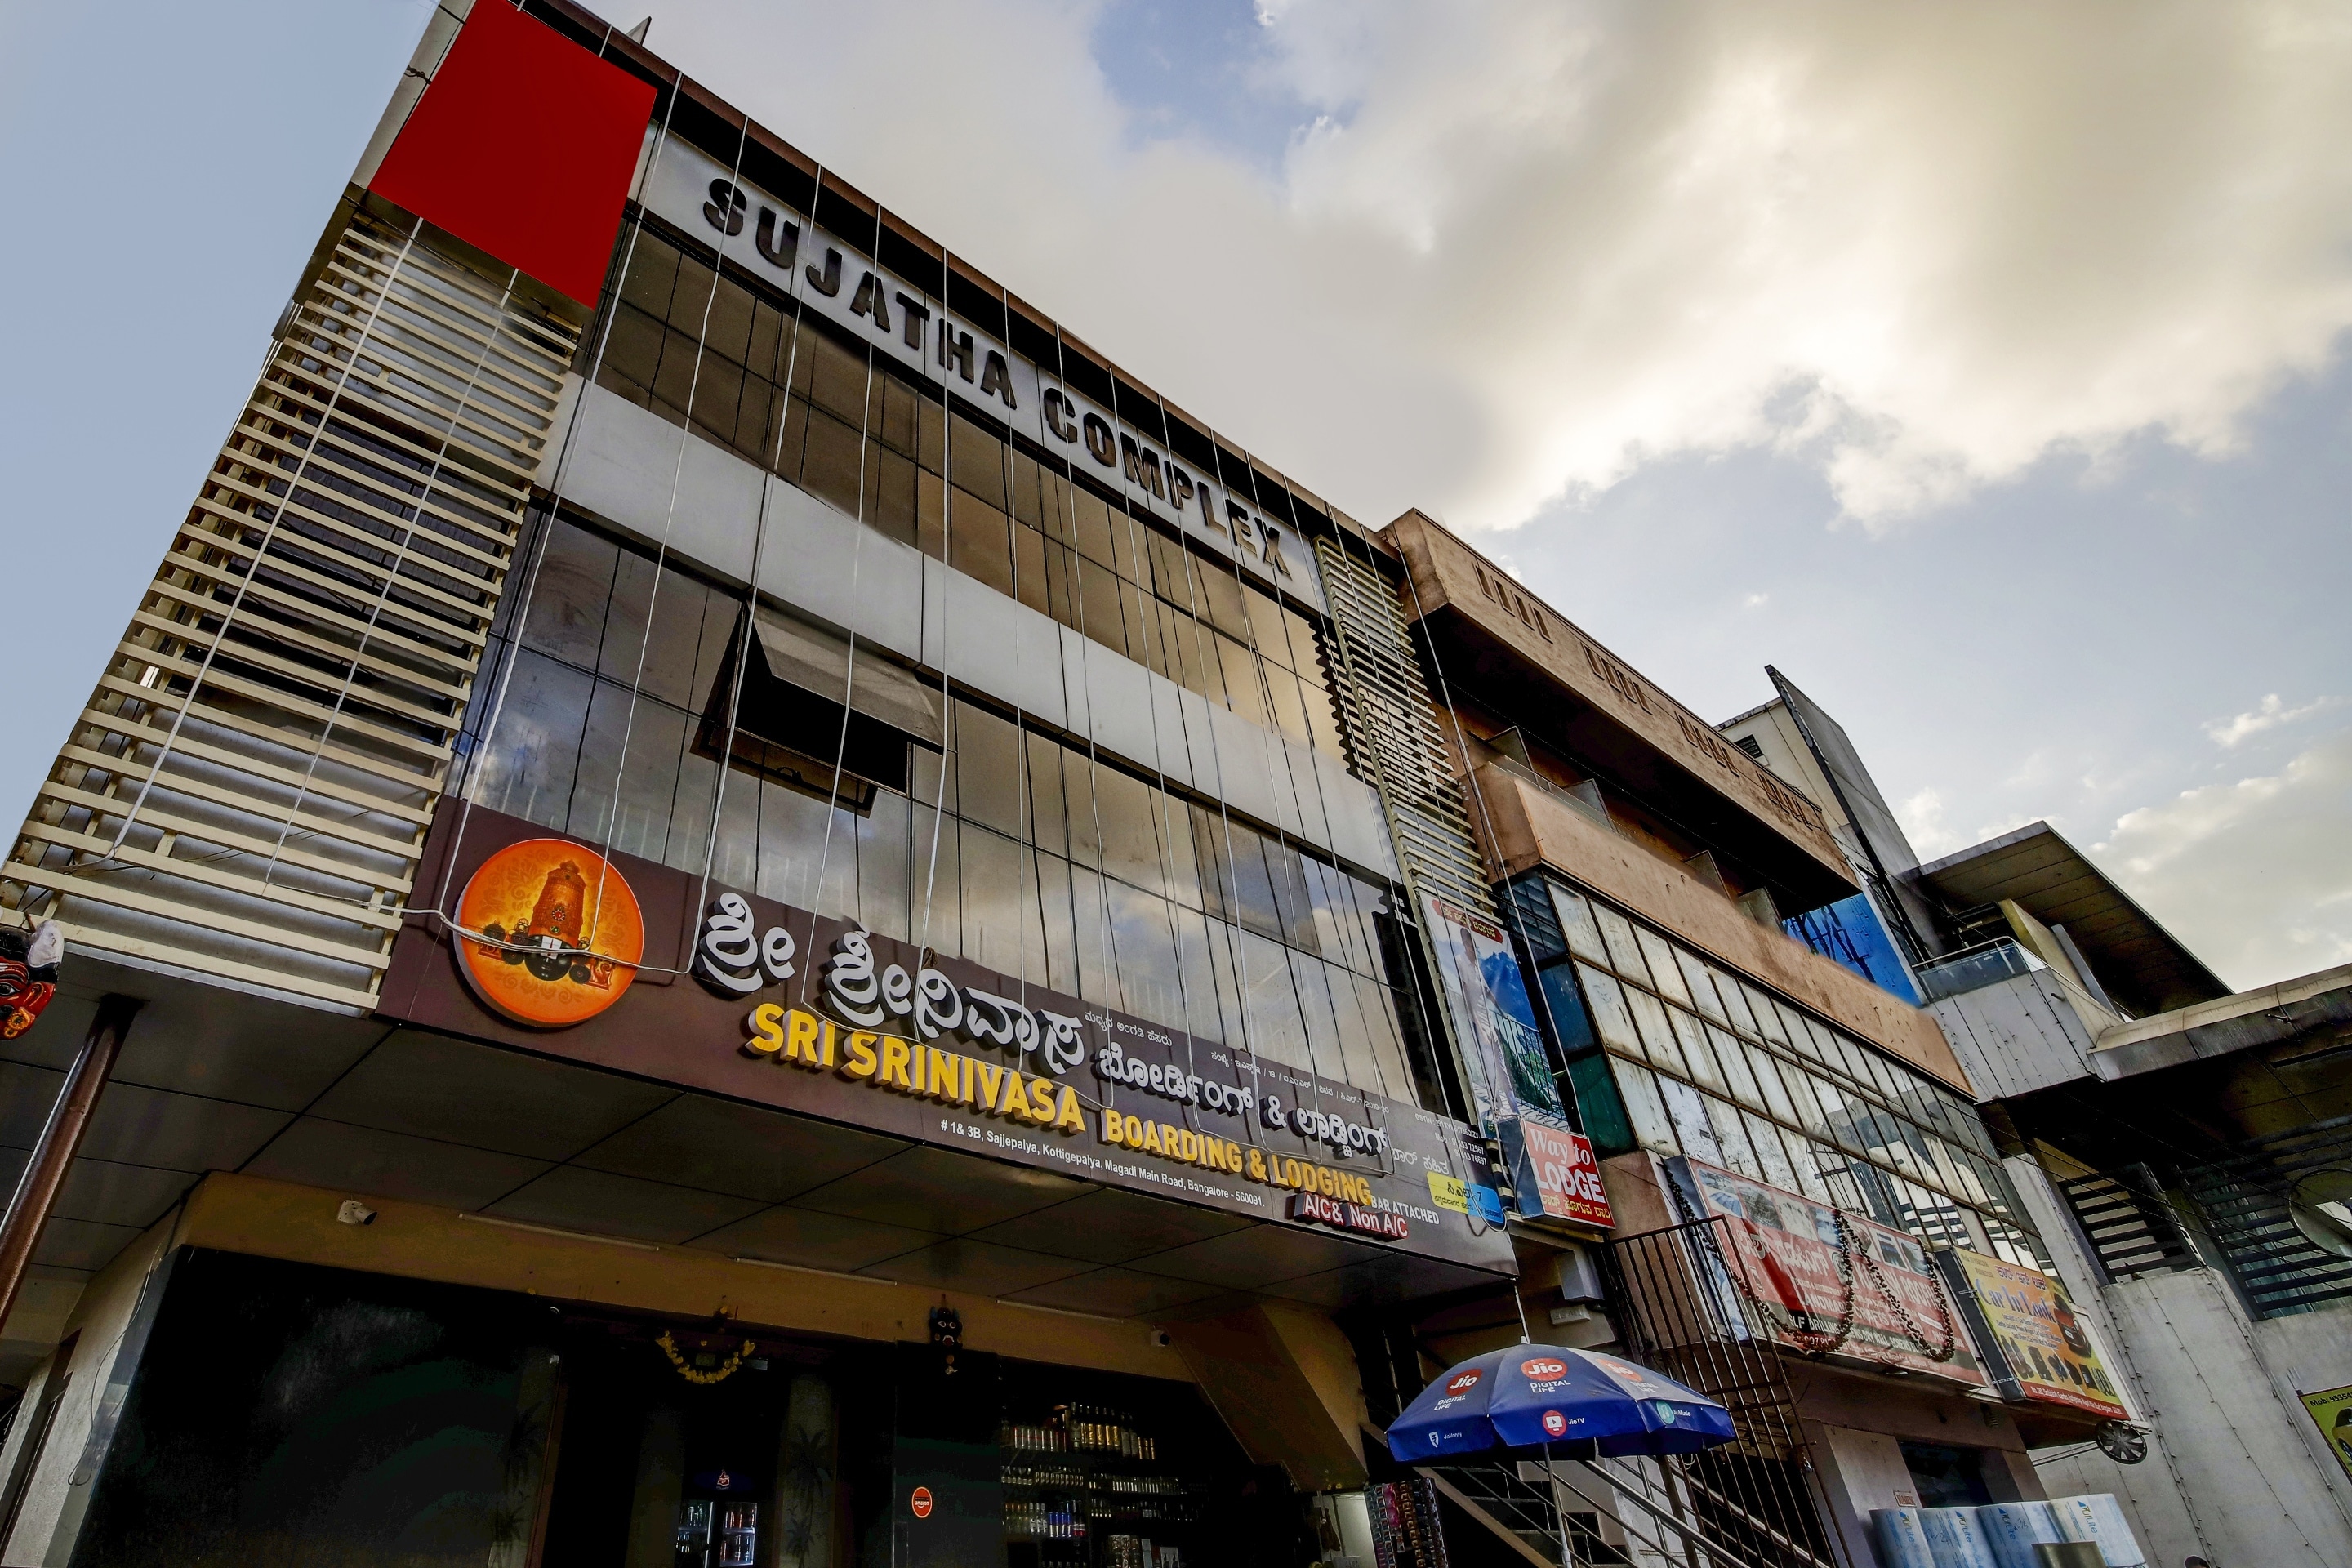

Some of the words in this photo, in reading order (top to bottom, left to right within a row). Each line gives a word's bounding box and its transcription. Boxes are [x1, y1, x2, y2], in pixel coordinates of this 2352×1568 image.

[703, 177, 1018, 410] SUJATHA
[1044, 386, 1292, 579] COMPLEX
[694, 892, 795, 993] ಶ್ರೀ
[826, 930, 1086, 1076] ಶ್ರೀನಿವಾಸ
[746, 1003, 836, 1067] SRI
[842, 1030, 1086, 1134] SRINIVASA
[1267, 1095, 1287, 1128] &
[1103, 1109, 1243, 1174] BOARDING
[1247, 1149, 1267, 1183] &
[1271, 1155, 1372, 1205] LODGING
[1529, 1128, 1568, 1165] Way
[1574, 1143, 1590, 1165] to
[968, 1126, 984, 1142] 3B,
[987, 1130, 1040, 1156] Sajjepalya,
[1043, 1144, 1103, 1170] Kottigepalya,
[1105, 1160, 1136, 1177] Magadi
[1139, 1169, 1160, 1182] Main
[1161, 1173, 1186, 1191] Road,
[1187, 1179, 1229, 1198] Bangalore
[1235, 1191, 1265, 1207] 560091.
[1530, 1157, 1606, 1204] LODGE
[1349, 1205, 1380, 1232] Non
[1383, 1214, 1408, 1238] A/C
[1371, 1195, 1391, 1213] BAR
[1392, 1200, 1439, 1225] ATTACHED
[1450, 1374, 1477, 1389] Jio
[1528, 1362, 1563, 1375] Jio
[1530, 1379, 1571, 1388] DIGITAL
[1434, 1402, 1452, 1410] LIFE
[1437, 1395, 1466, 1405] DIGITAL
[2309, 1397, 2330, 1406] Mob:
[1568, 1417, 1584, 1426] JioTV
